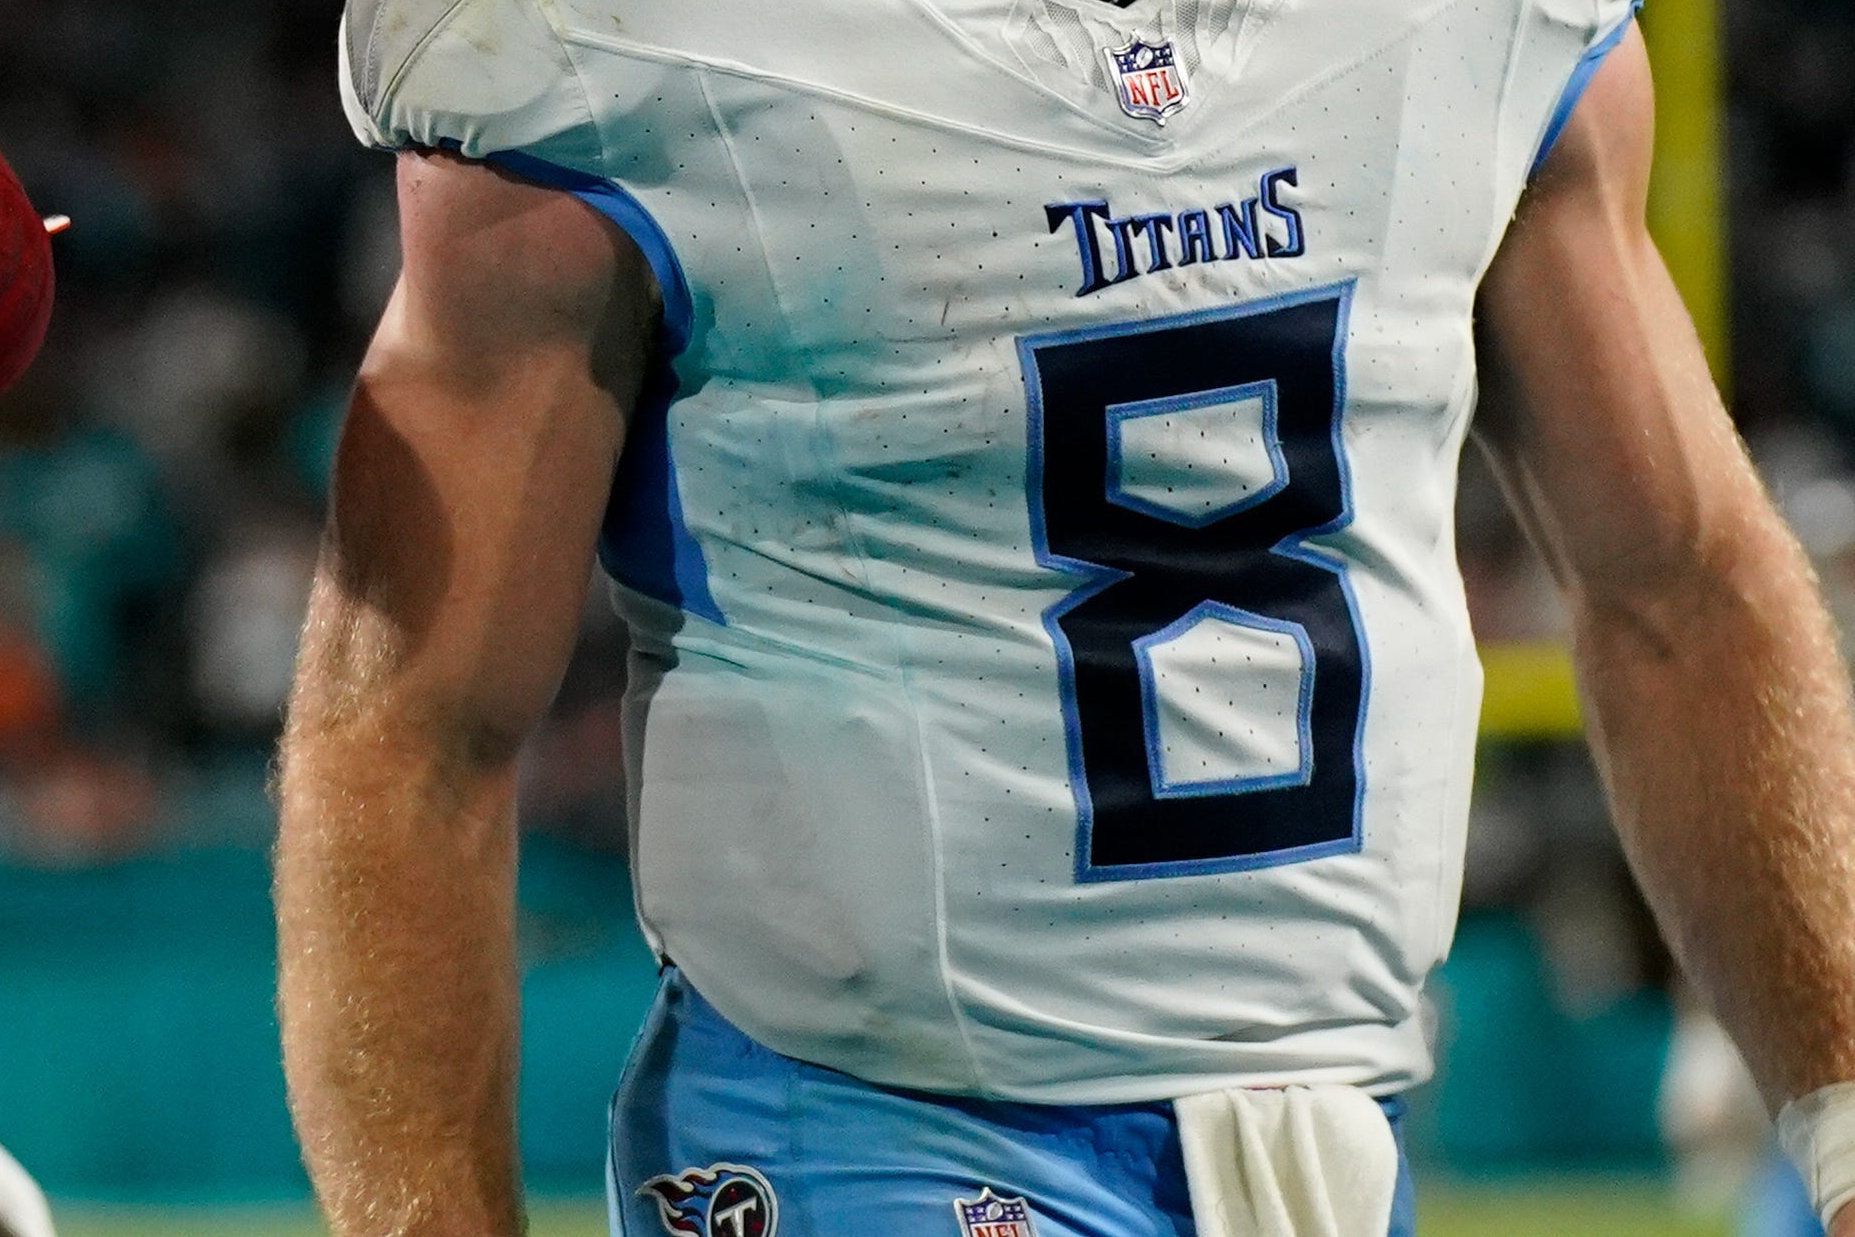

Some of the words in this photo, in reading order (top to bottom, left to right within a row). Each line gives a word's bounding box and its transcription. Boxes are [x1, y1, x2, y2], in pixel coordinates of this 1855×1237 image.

[1126, 70, 1179, 107] NFL
[1045, 164, 1306, 300] TITANS
[1014, 277, 1372, 884] 8
